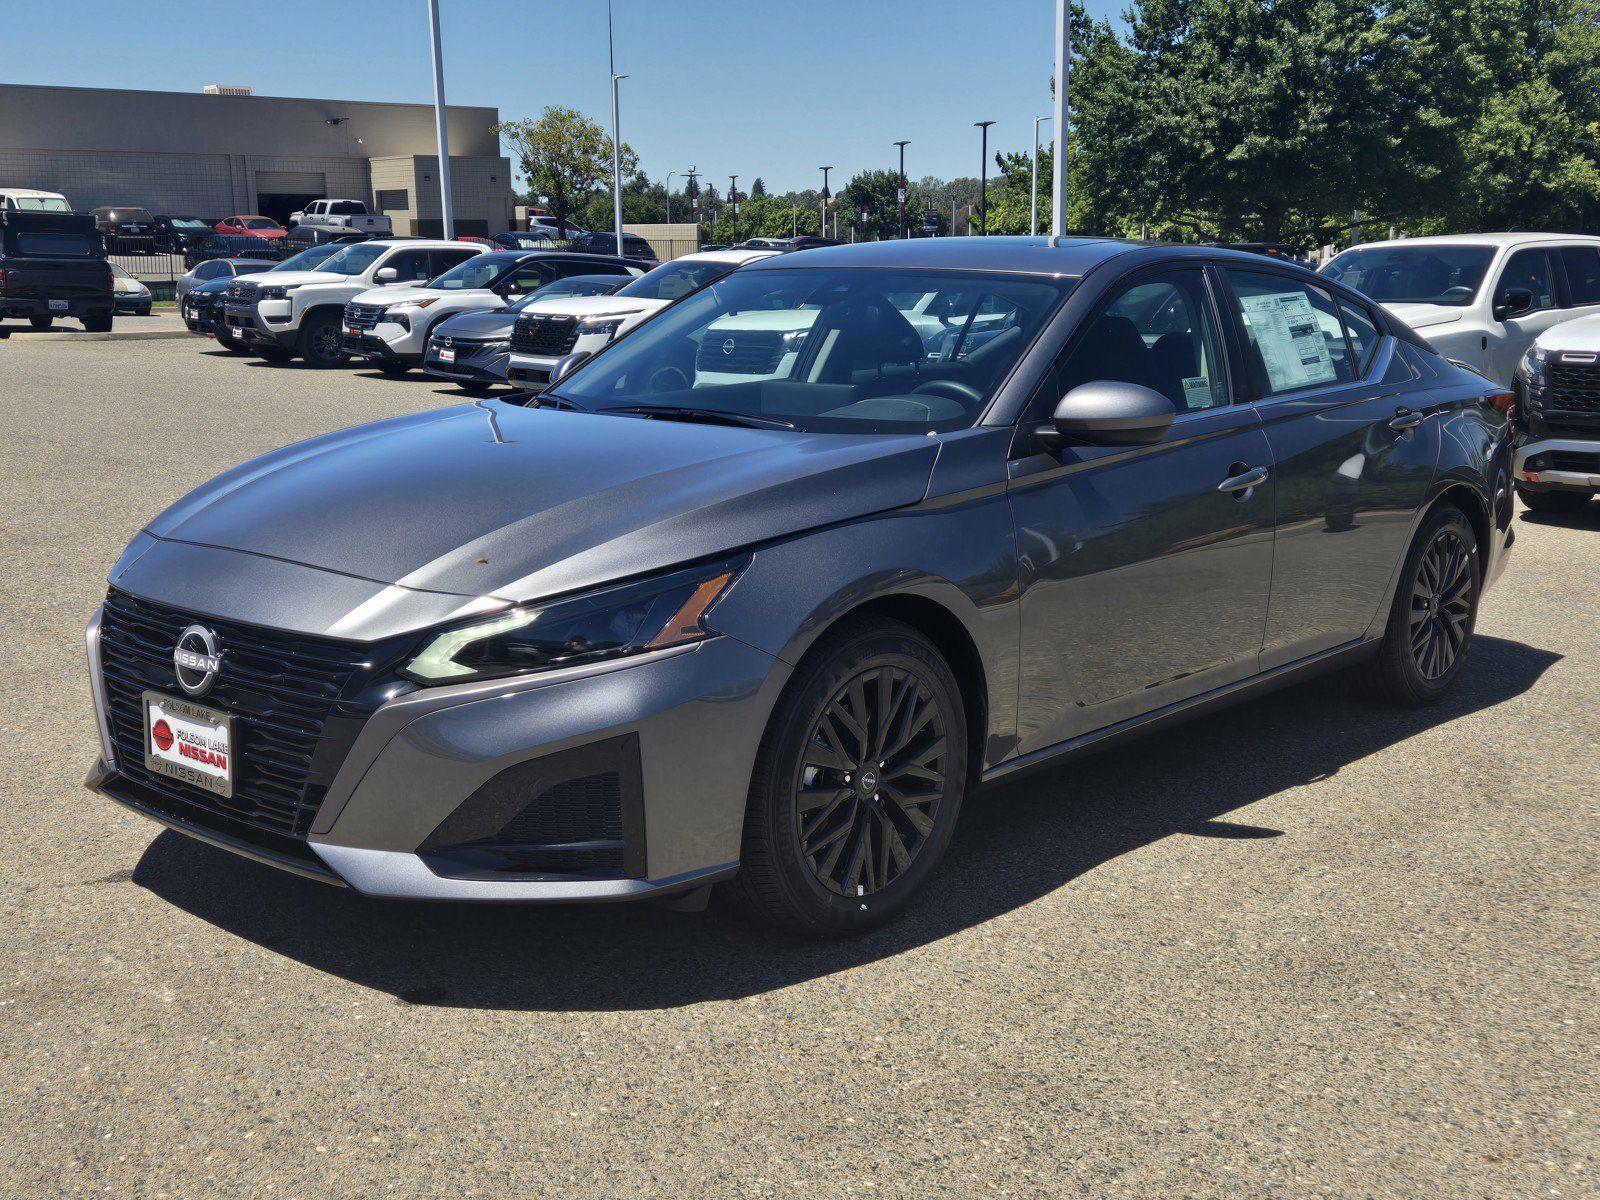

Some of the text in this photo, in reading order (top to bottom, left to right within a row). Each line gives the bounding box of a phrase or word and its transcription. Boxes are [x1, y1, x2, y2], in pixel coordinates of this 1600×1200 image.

[174, 649, 218, 671] NISSAN
[163, 698, 211, 722] FOLSOM LAKE
[177, 728, 229, 755] FOLSOM LAKE
[178, 741, 227, 770] NISSAN
[165, 762, 213, 788] NISSAN
